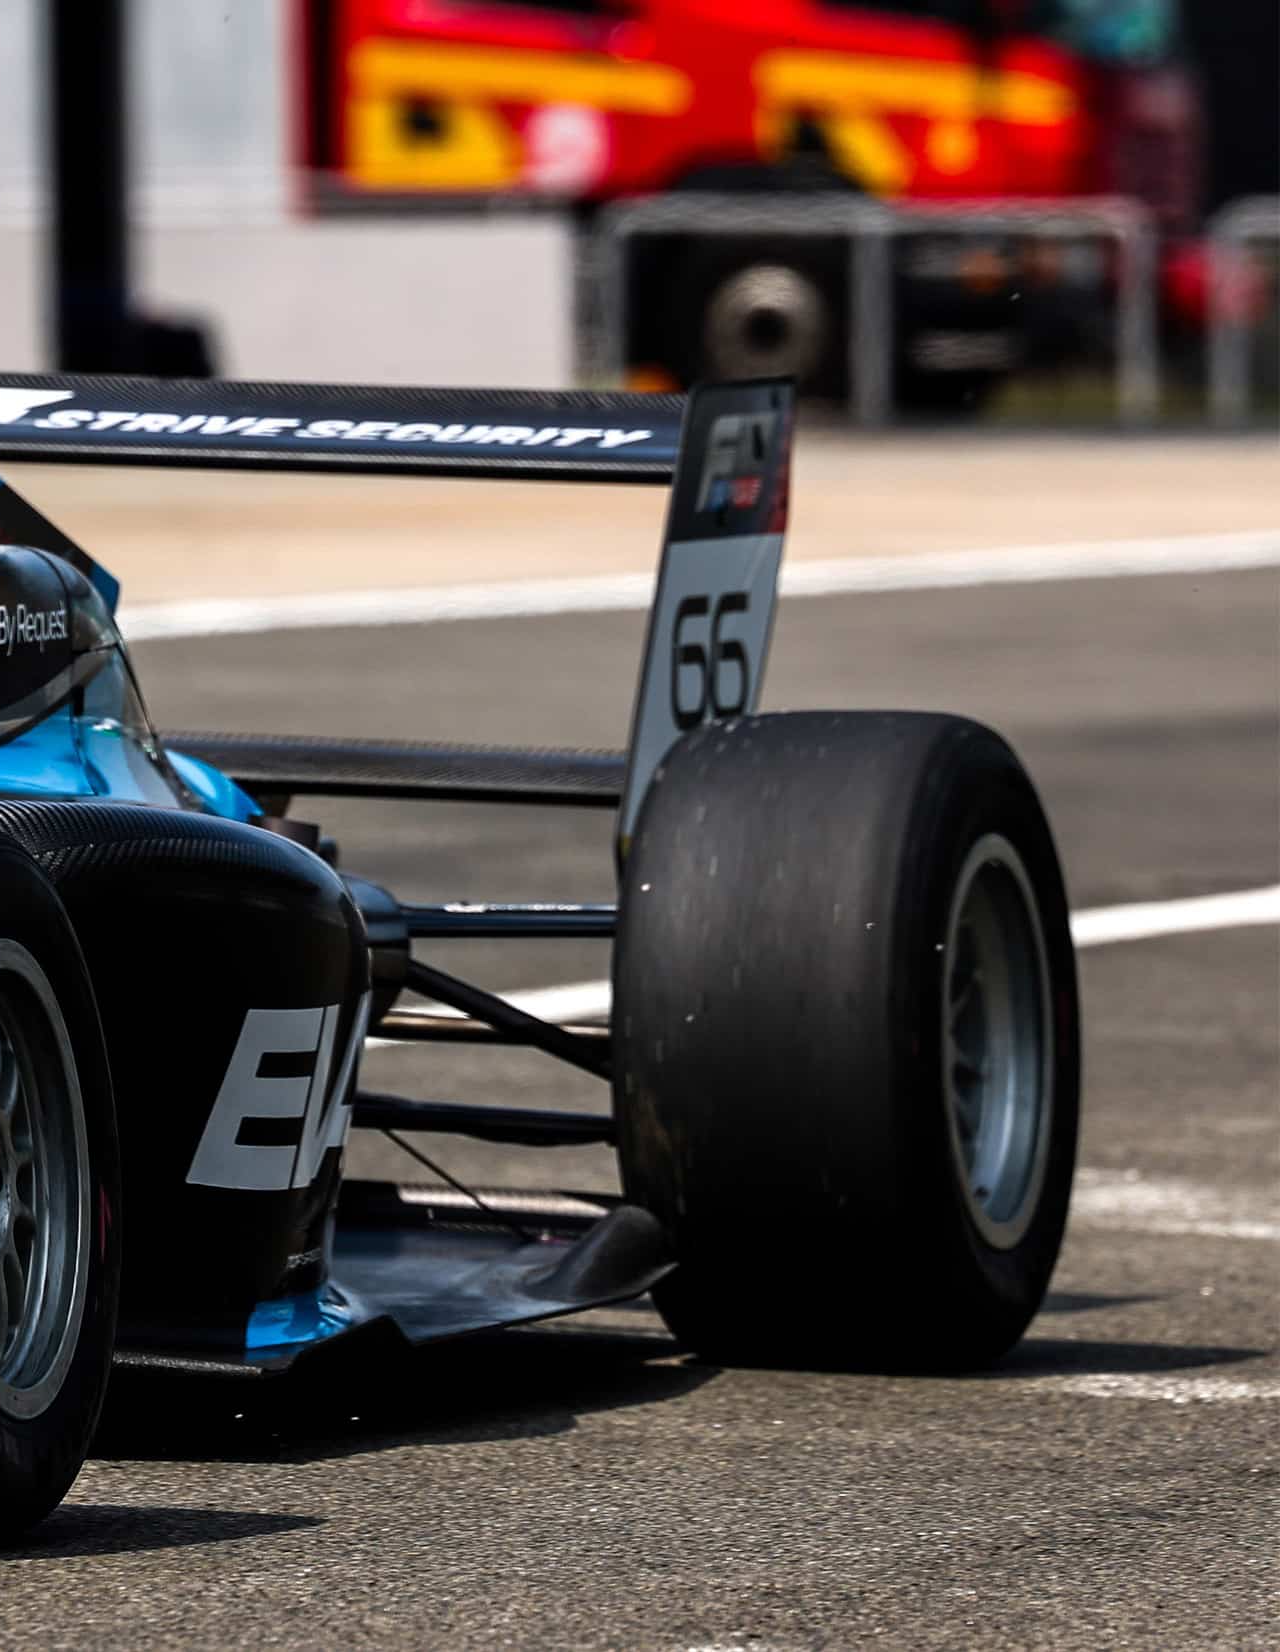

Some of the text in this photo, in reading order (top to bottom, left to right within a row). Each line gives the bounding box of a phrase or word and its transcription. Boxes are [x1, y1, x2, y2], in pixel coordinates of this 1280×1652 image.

[34, 409, 652, 449] STRIVE SECURITY
[670, 591, 750, 733] 66
